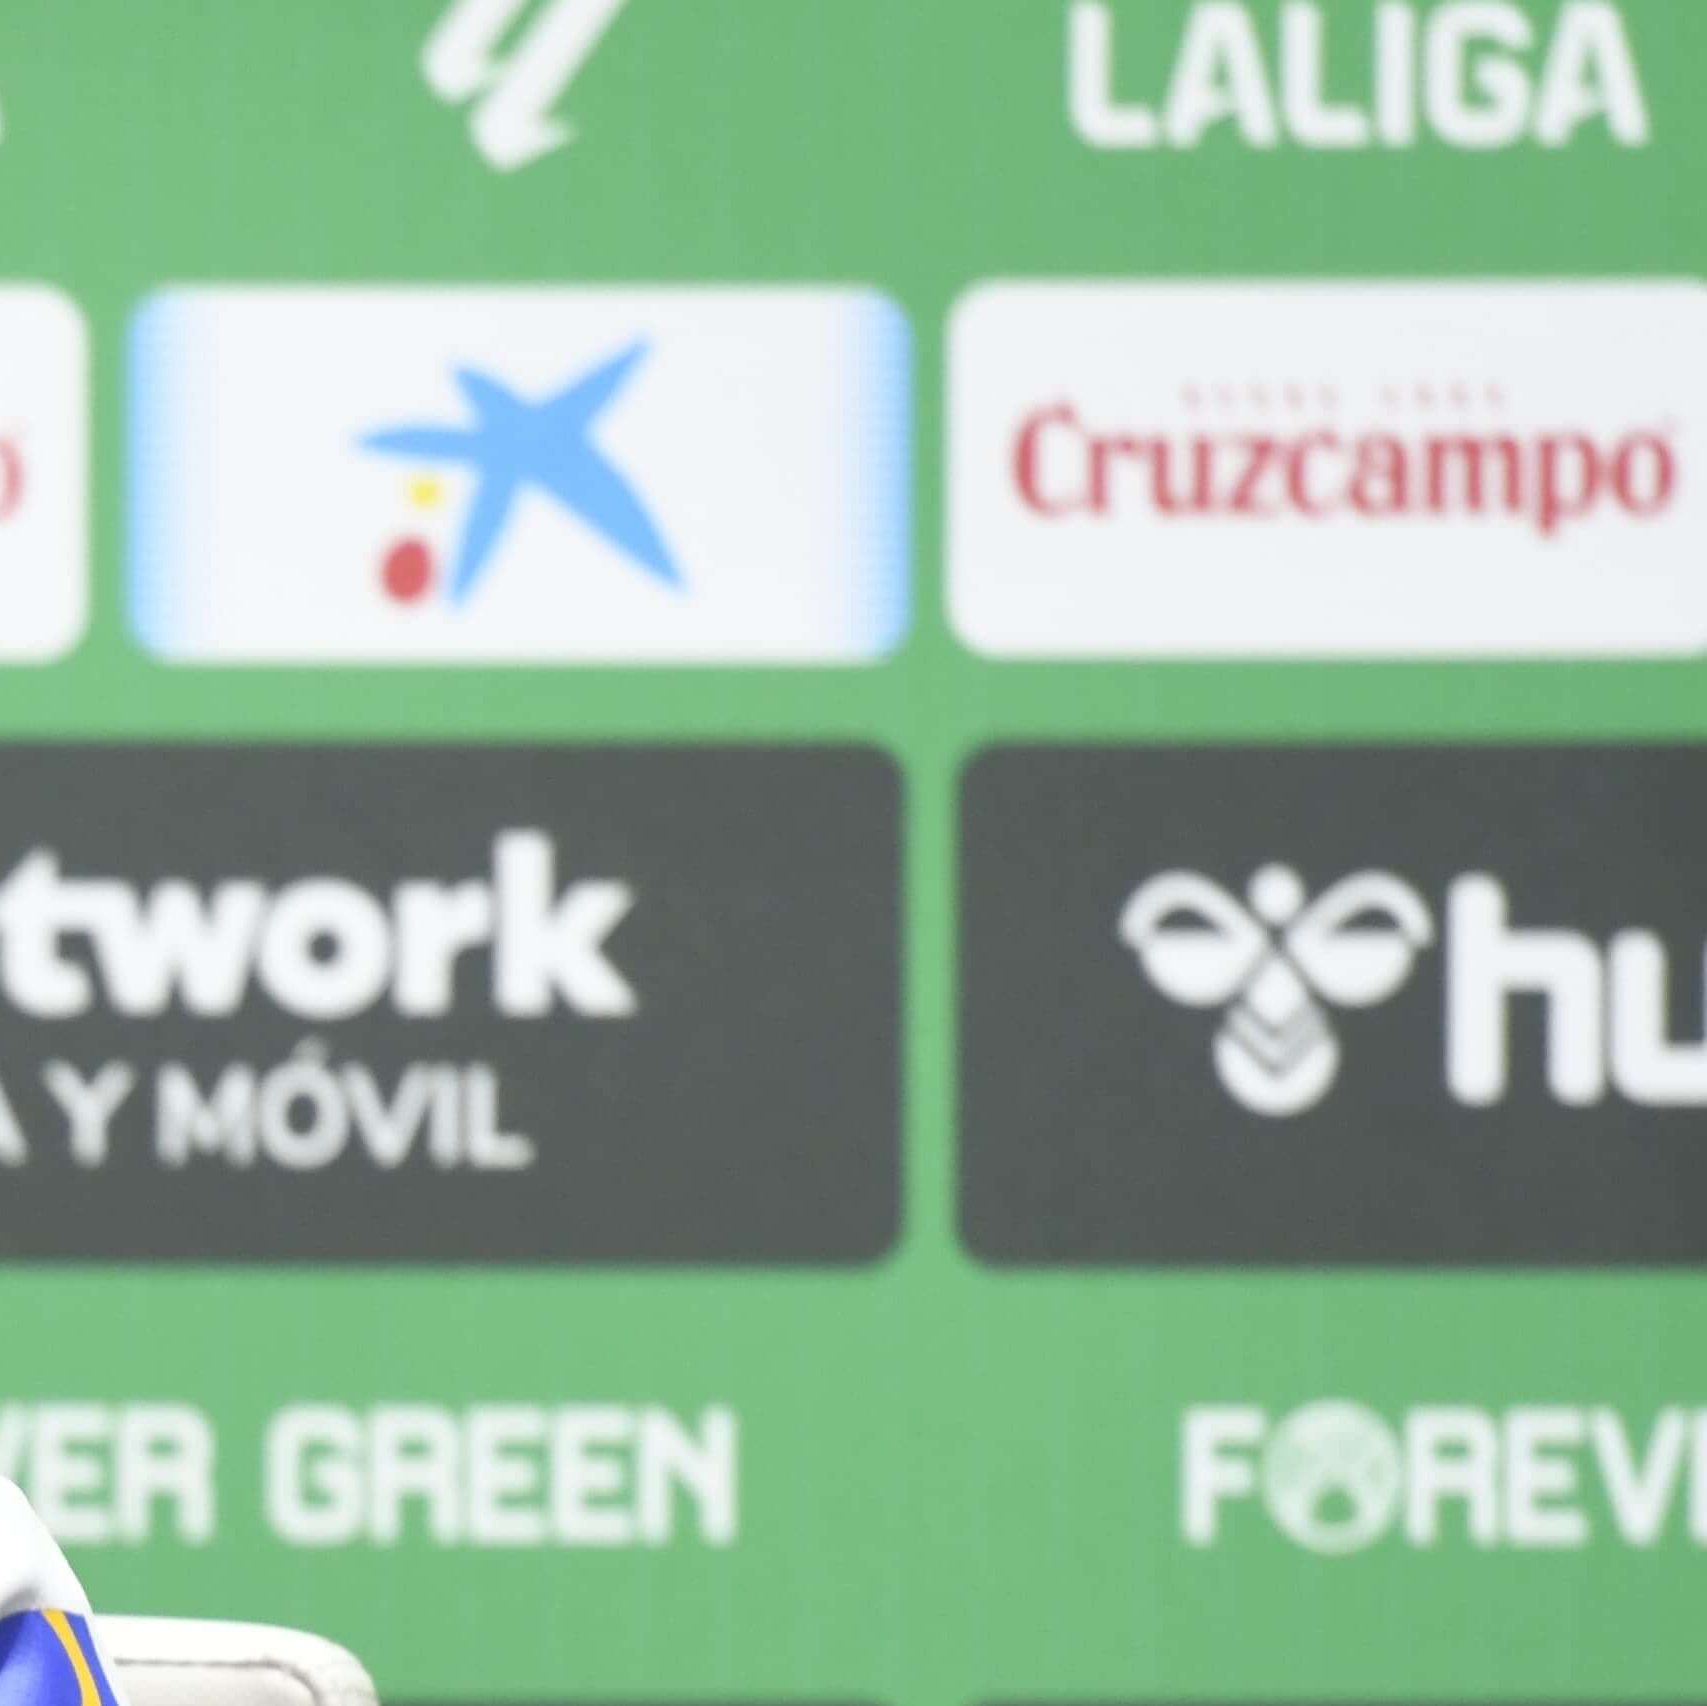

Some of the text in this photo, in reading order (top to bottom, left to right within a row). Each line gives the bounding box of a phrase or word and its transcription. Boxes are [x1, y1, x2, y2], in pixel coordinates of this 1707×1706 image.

[1069, 0, 1648, 148] LALIGA
[1011, 402, 1679, 540] Cruzcampo
[45, 1062, 133, 1166] Y
[156, 1038, 533, 1169] MÓVIL
[264, 1402, 737, 1546] GREEN
[1180, 1399, 1707, 1554] FOREV
